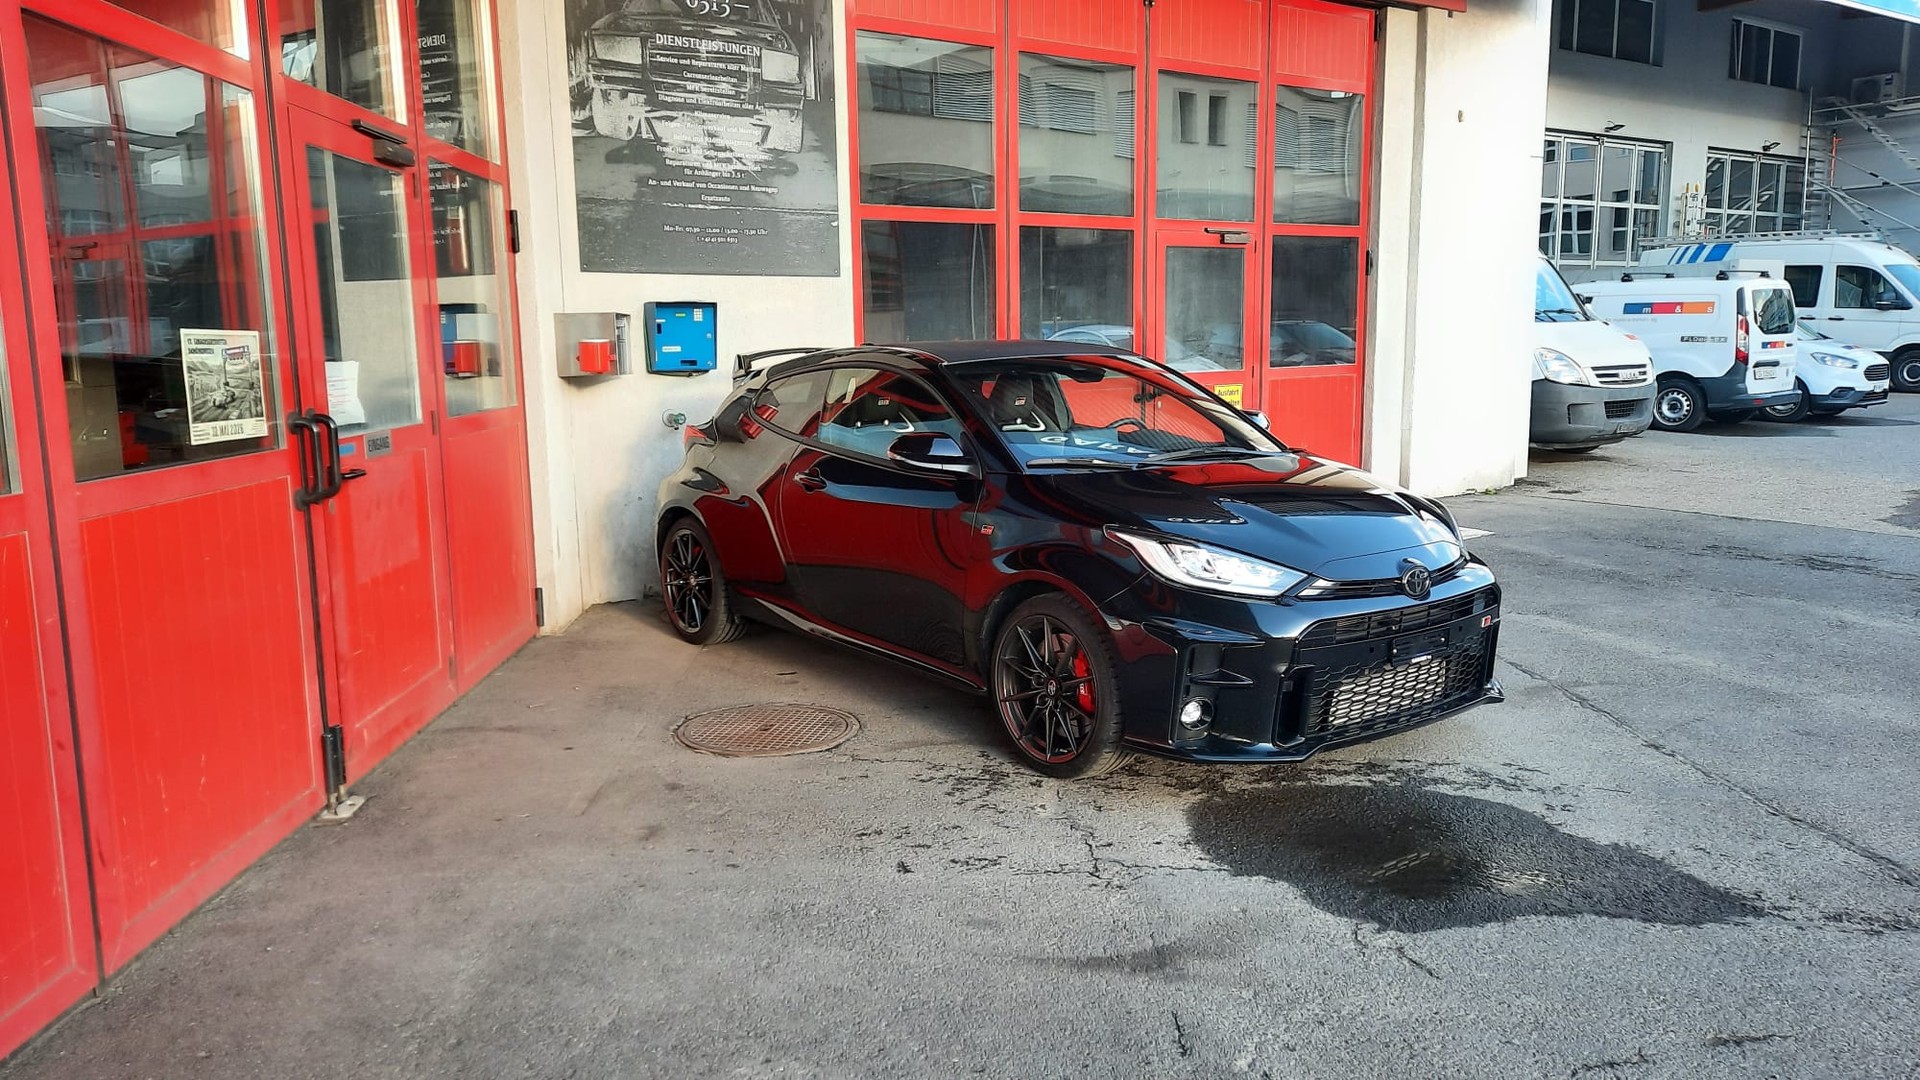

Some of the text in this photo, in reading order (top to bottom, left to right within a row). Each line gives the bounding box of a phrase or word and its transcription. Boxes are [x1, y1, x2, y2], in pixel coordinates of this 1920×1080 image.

[656, 33, 760, 57] DIENSTLEISTUNGEN
[660, 179, 672, 187] und
[672, 180, 695, 188] Verkauf
[1674, 305, 1682, 313] &
